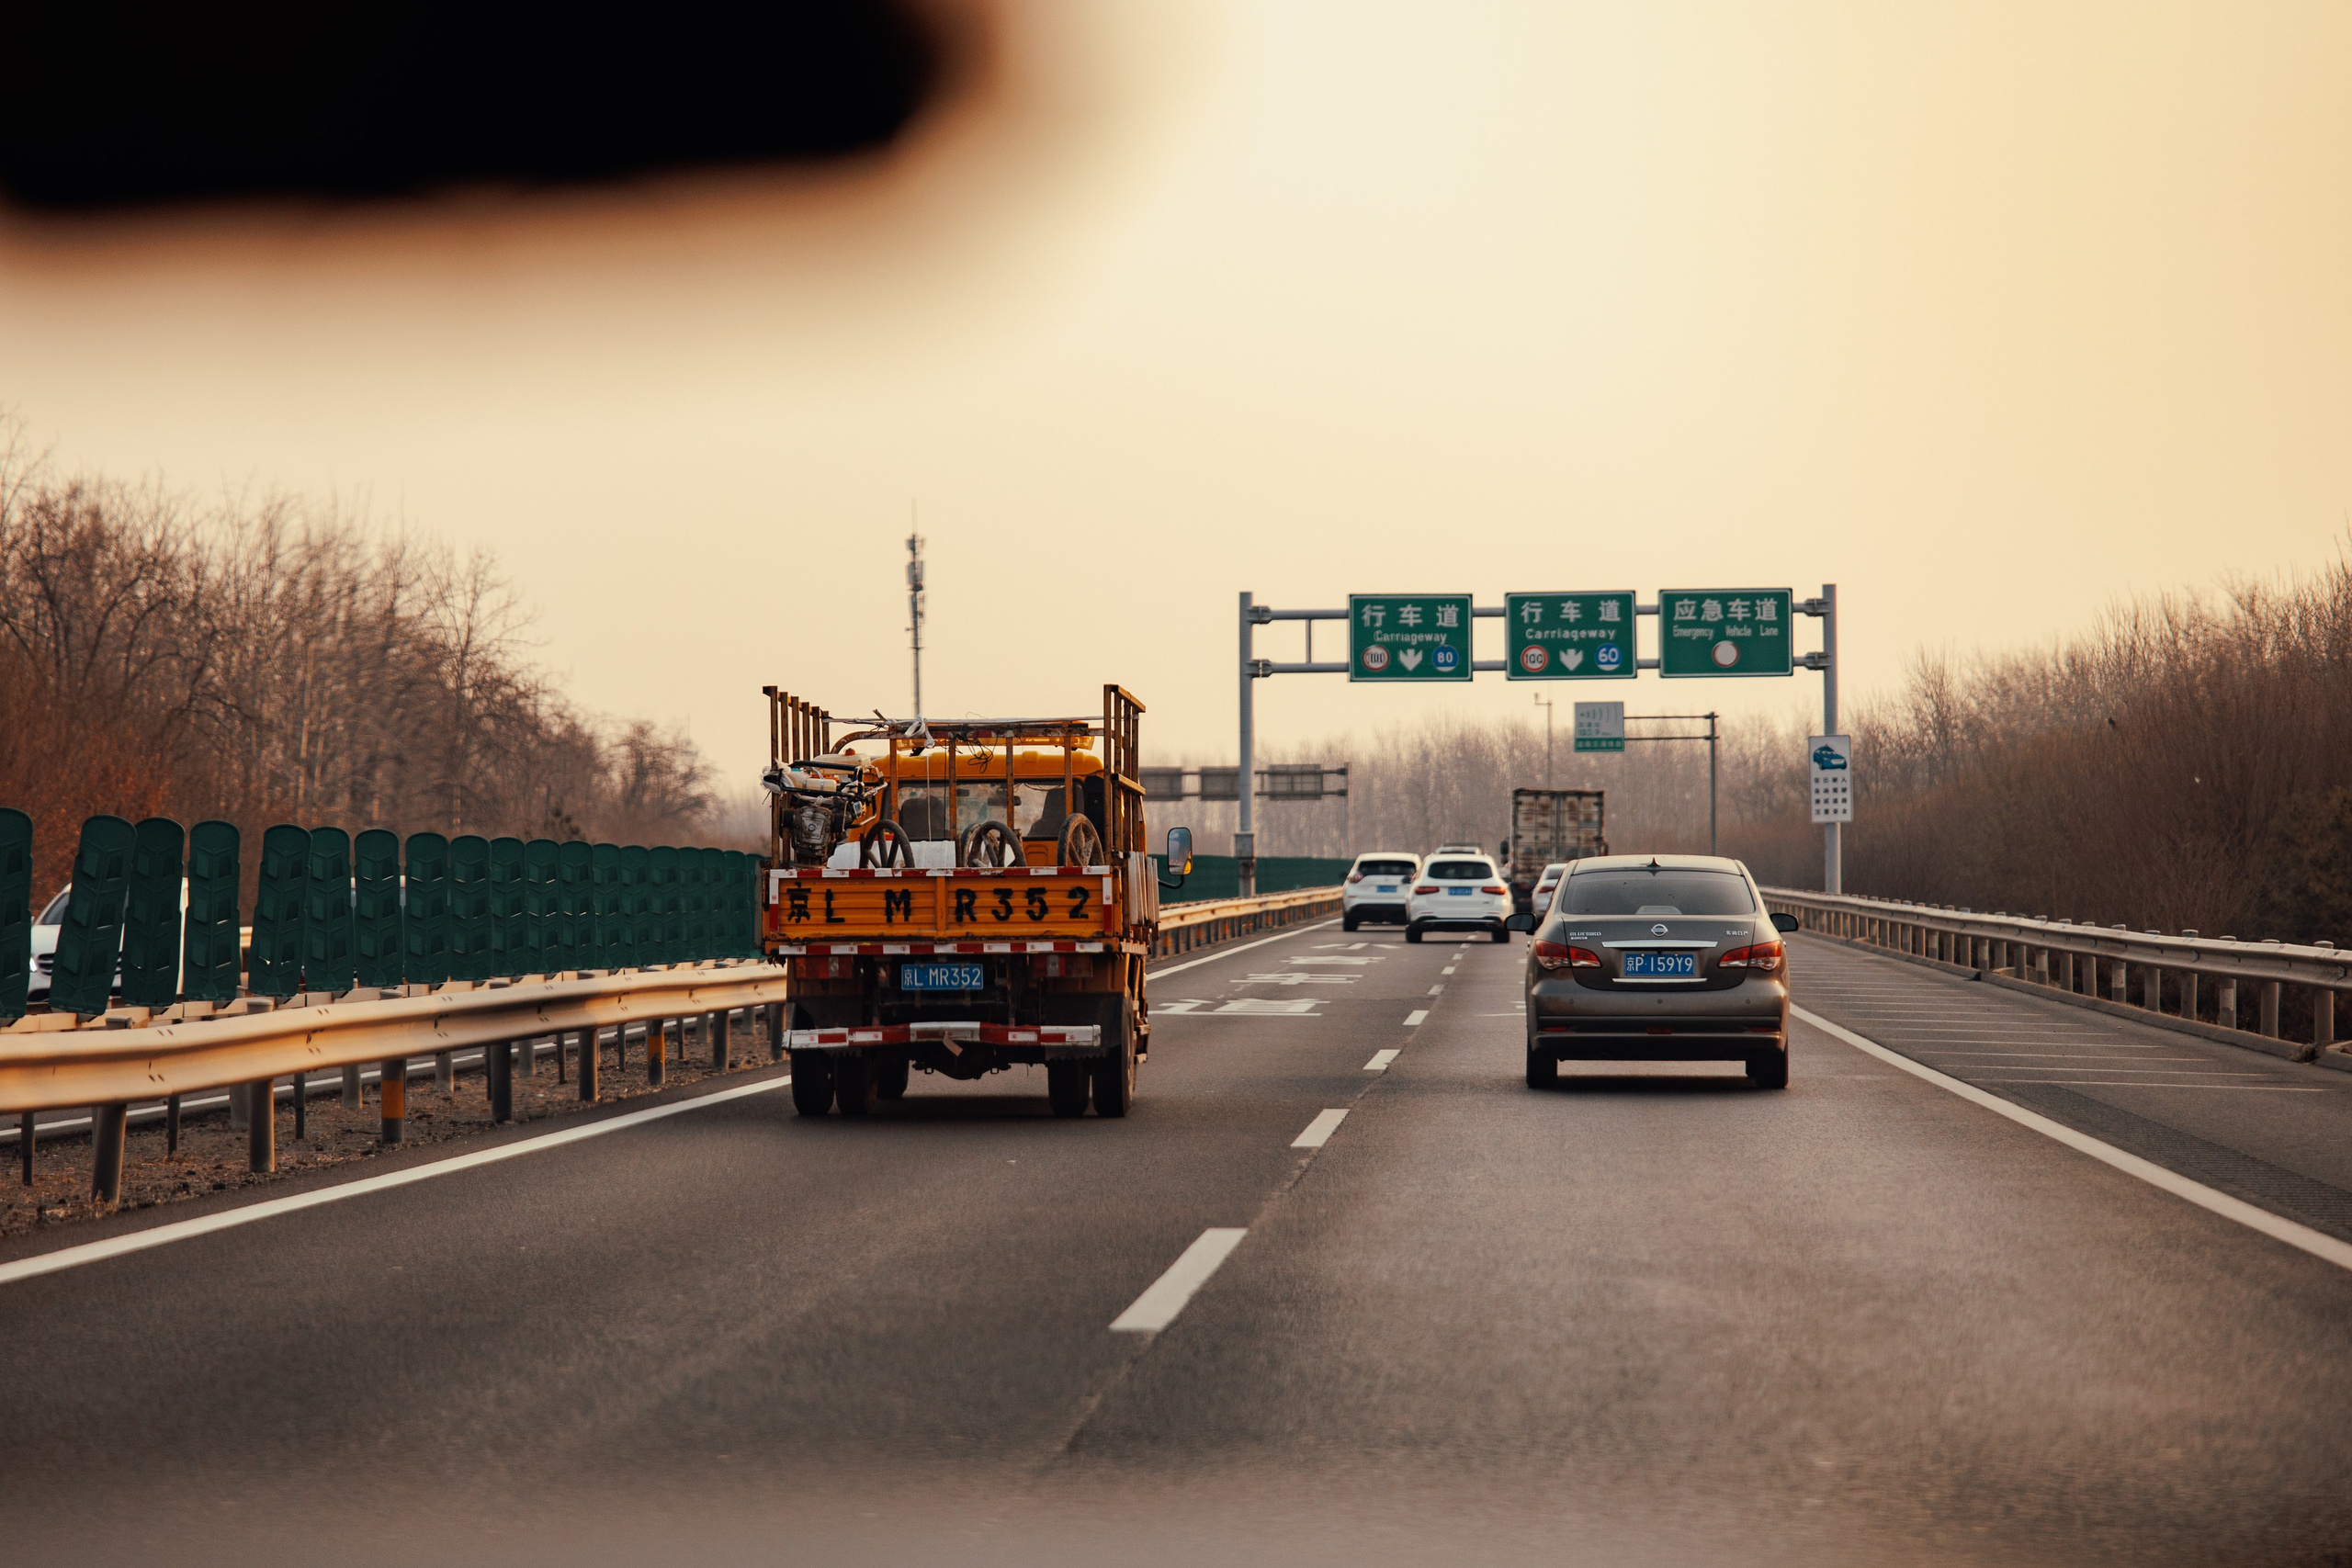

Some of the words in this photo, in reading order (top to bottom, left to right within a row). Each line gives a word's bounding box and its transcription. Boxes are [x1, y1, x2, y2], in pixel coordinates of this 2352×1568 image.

[1362, 604, 1459, 627] 行车道
[1521, 600, 1621, 623] 行车道
[1673, 598, 1778, 621] 应急车道
[1374, 630, 1447, 645] Carriageway
[1525, 628, 1615, 641] Carriageway
[1673, 626, 1713, 640] Emergency
[1724, 625, 1752, 637] Vehicle
[1759, 625, 1779, 637] Lane
[1437, 651, 1453, 663] 80
[1525, 653, 1544, 664] 100
[1598, 648, 1619, 662] 60
